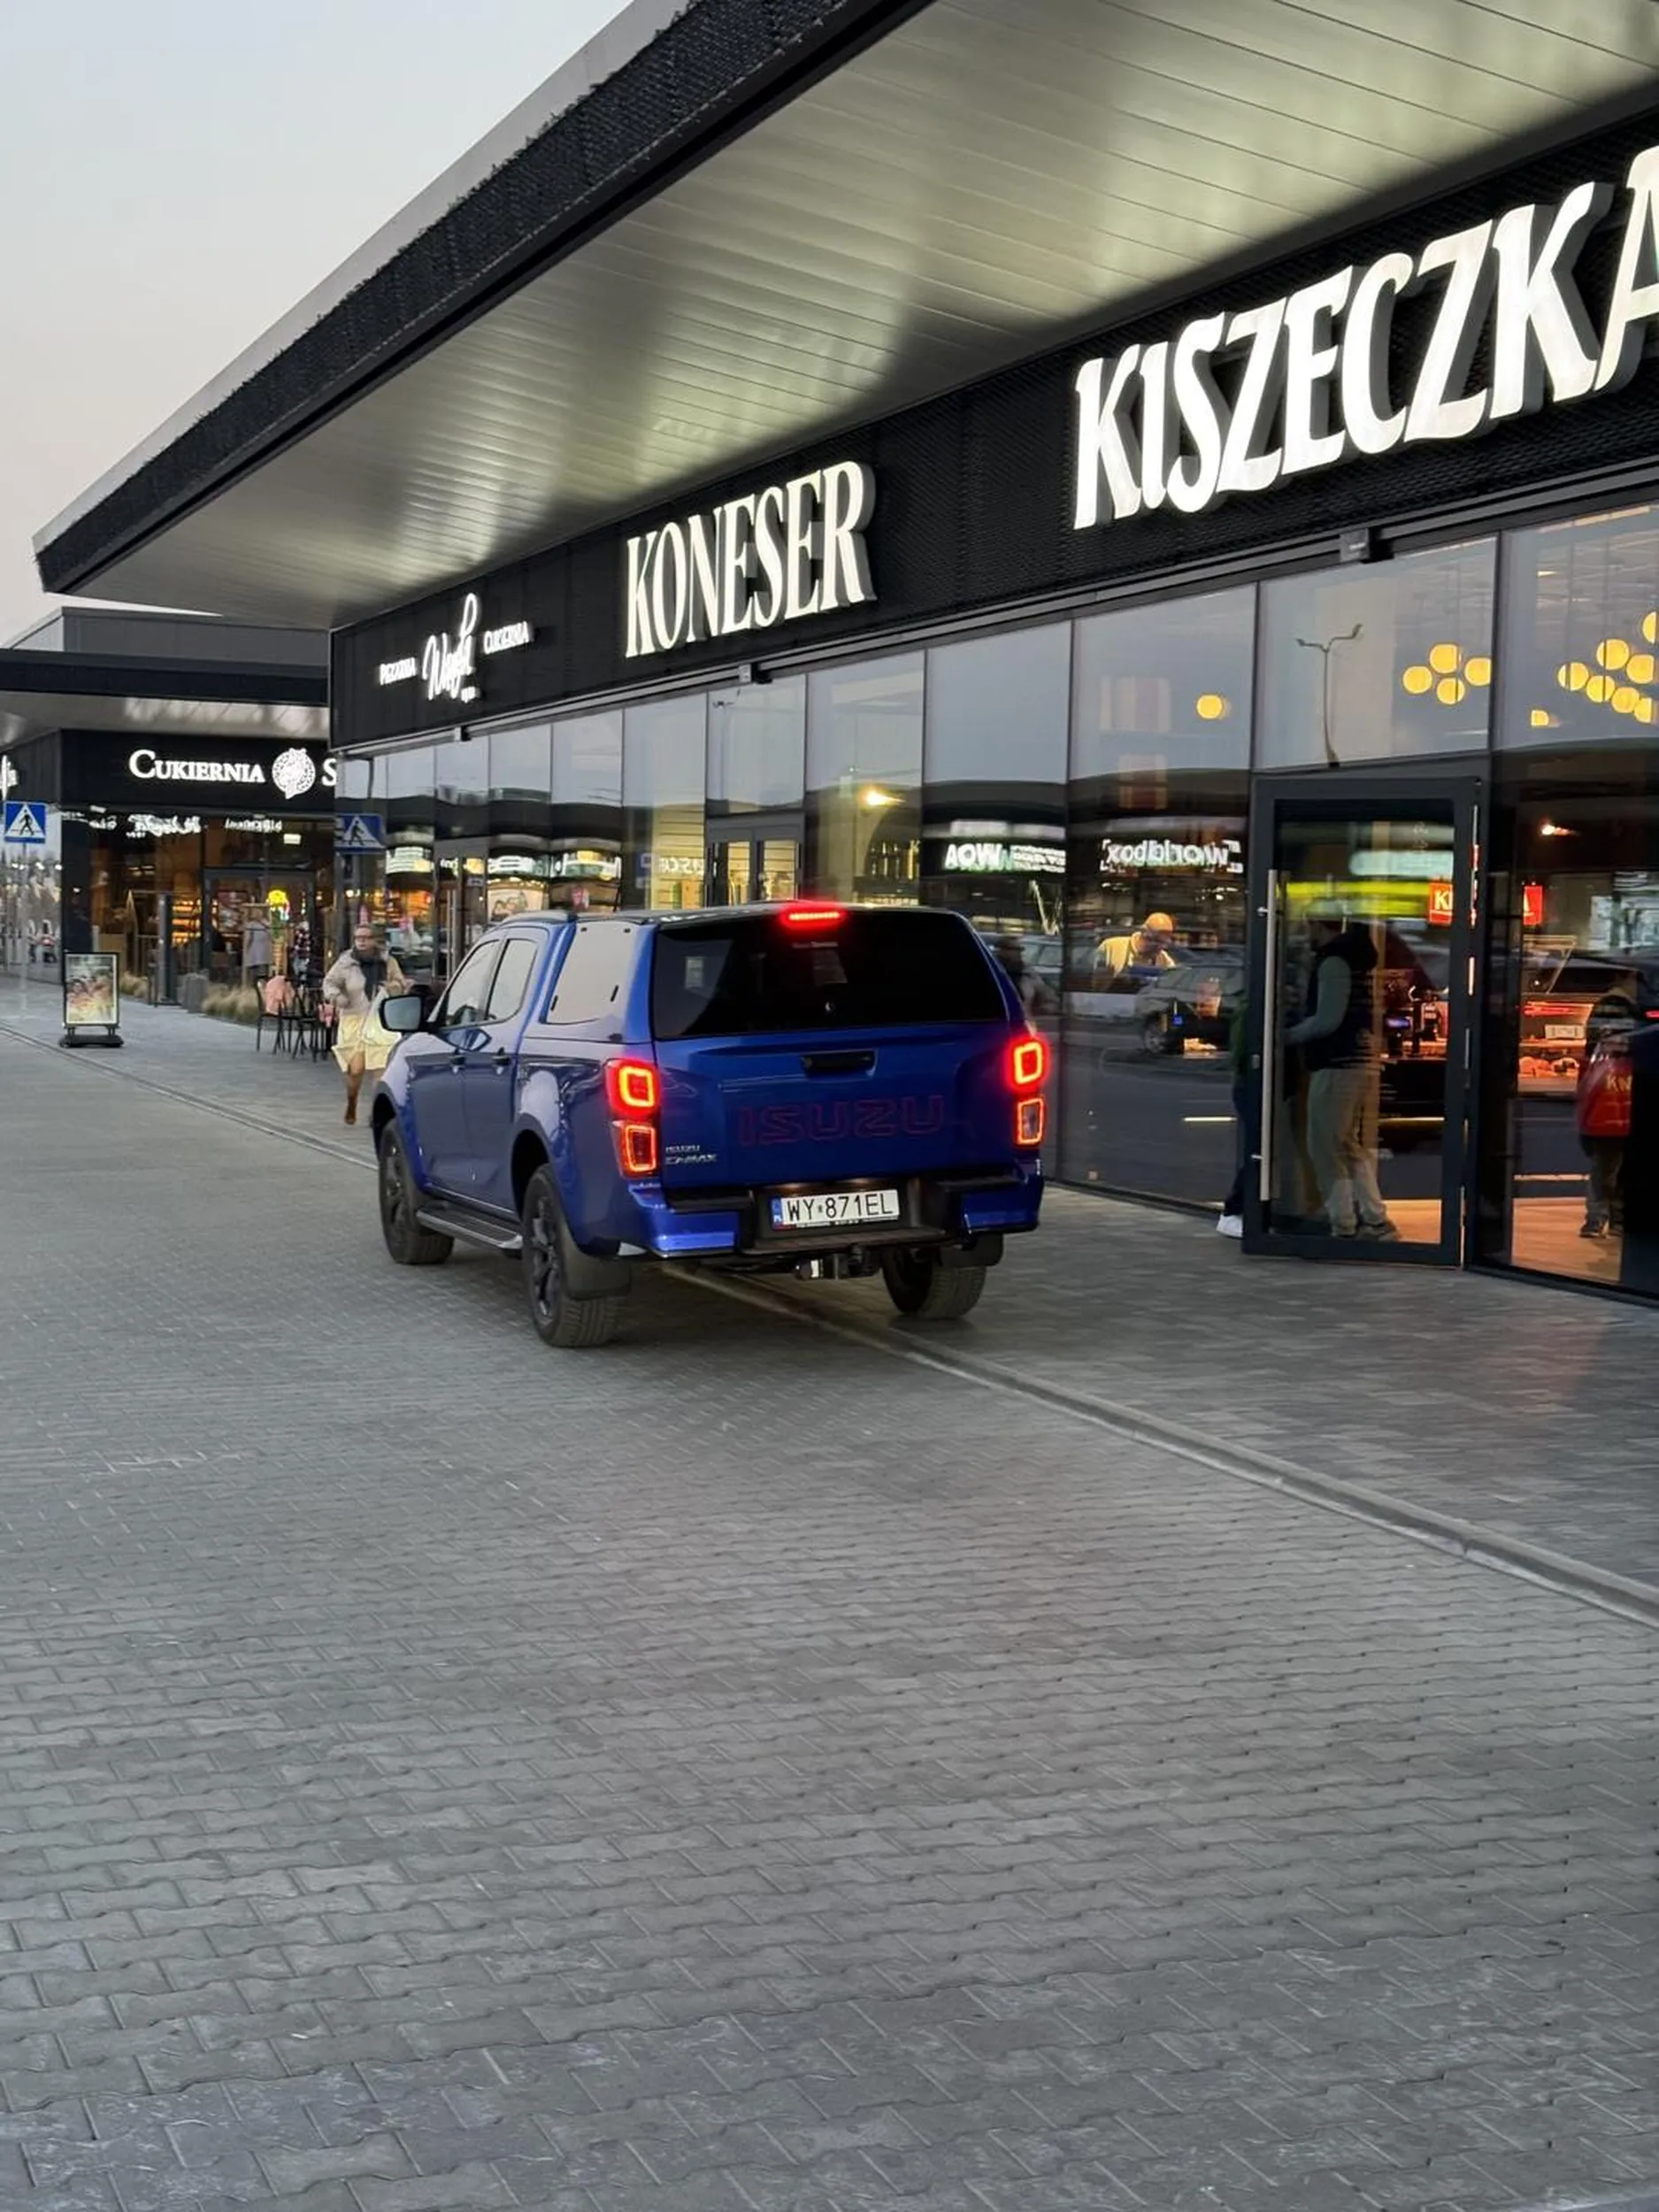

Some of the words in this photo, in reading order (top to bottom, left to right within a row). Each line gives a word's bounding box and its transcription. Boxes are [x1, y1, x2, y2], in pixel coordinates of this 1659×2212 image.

[1072, 144, 1659, 530] KISZECZKA
[625, 460, 874, 658] KONESER
[128, 749, 265, 783] CUKIERNIA
[740, 1094, 945, 1147] ISUZU
[825, 1193, 894, 1218] 871EL
